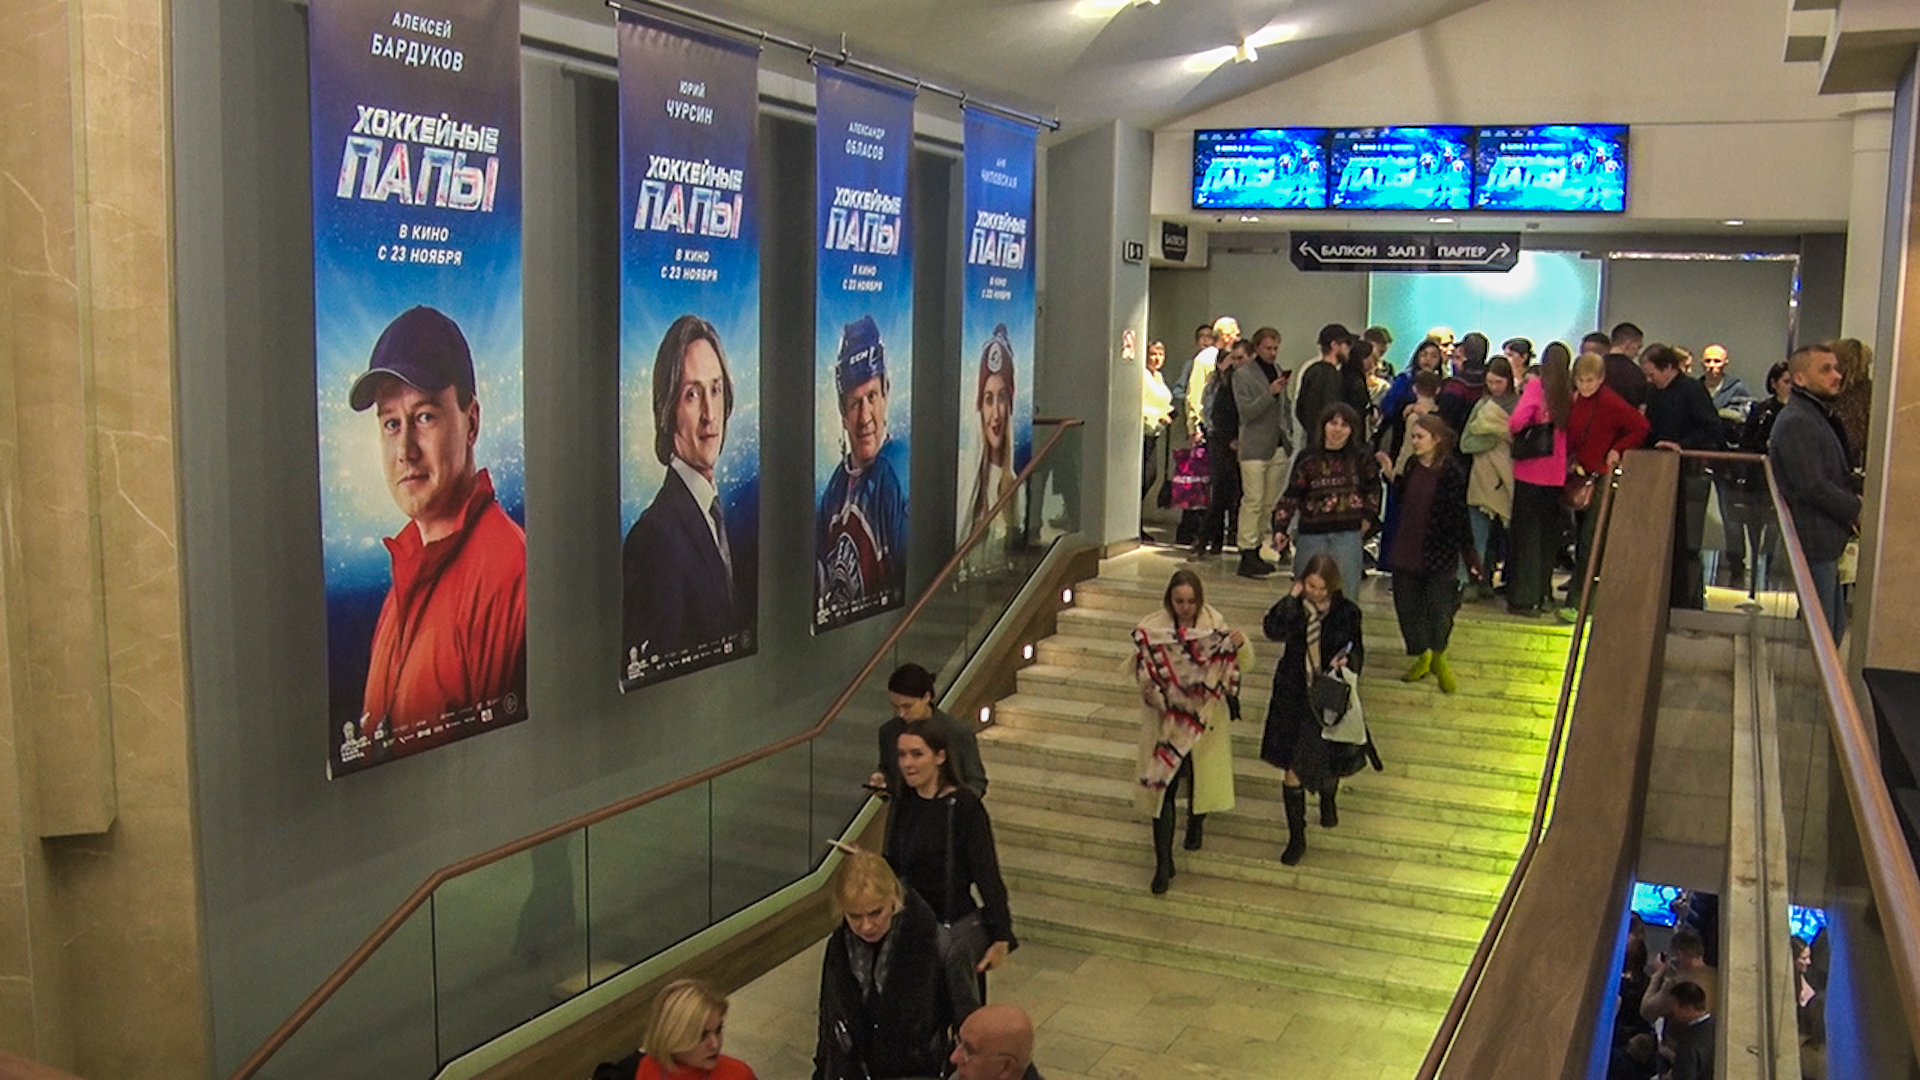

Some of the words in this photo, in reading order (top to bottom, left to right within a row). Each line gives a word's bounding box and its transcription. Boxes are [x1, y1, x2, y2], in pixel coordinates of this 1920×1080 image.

[391, 11, 453, 39] АЛЕКСЕЙ
[371, 33, 464, 72] БАРДУКОВ
[679, 80, 706, 98] ЮРИЙ
[666, 99, 714, 125] ЧУРСИН
[352, 105, 500, 154] ХОККЕЙНЫЕ
[845, 139, 885, 161] ОБЛАСОВ
[336, 135, 500, 213] ПАПЫ
[646, 155, 744, 191] ХОККЕЙНЫЕ
[633, 179, 744, 239] ПАПЫ
[833, 186, 902, 215] ХОККЕЙНЫЕ
[398, 223, 409, 239] В
[411, 225, 450, 242] КИНО
[825, 207, 901, 255] ПАПЫ
[377, 245, 387, 261] С
[390, 245, 407, 262] 23
[410, 248, 463, 265] НОЯБРЯ
[675, 249, 682, 261] В
[684, 250, 710, 264] КИНО
[968, 227, 1027, 270] ПАПЫ
[1320, 245, 1377, 258] БАЛКОН
[1387, 245, 1416, 258] ЗАЛ
[1437, 246, 1487, 258] ПАРТЕР
[661, 266, 668, 279] С
[669, 266, 681, 280] 23
[683, 268, 719, 282] НОЯБРЯ
